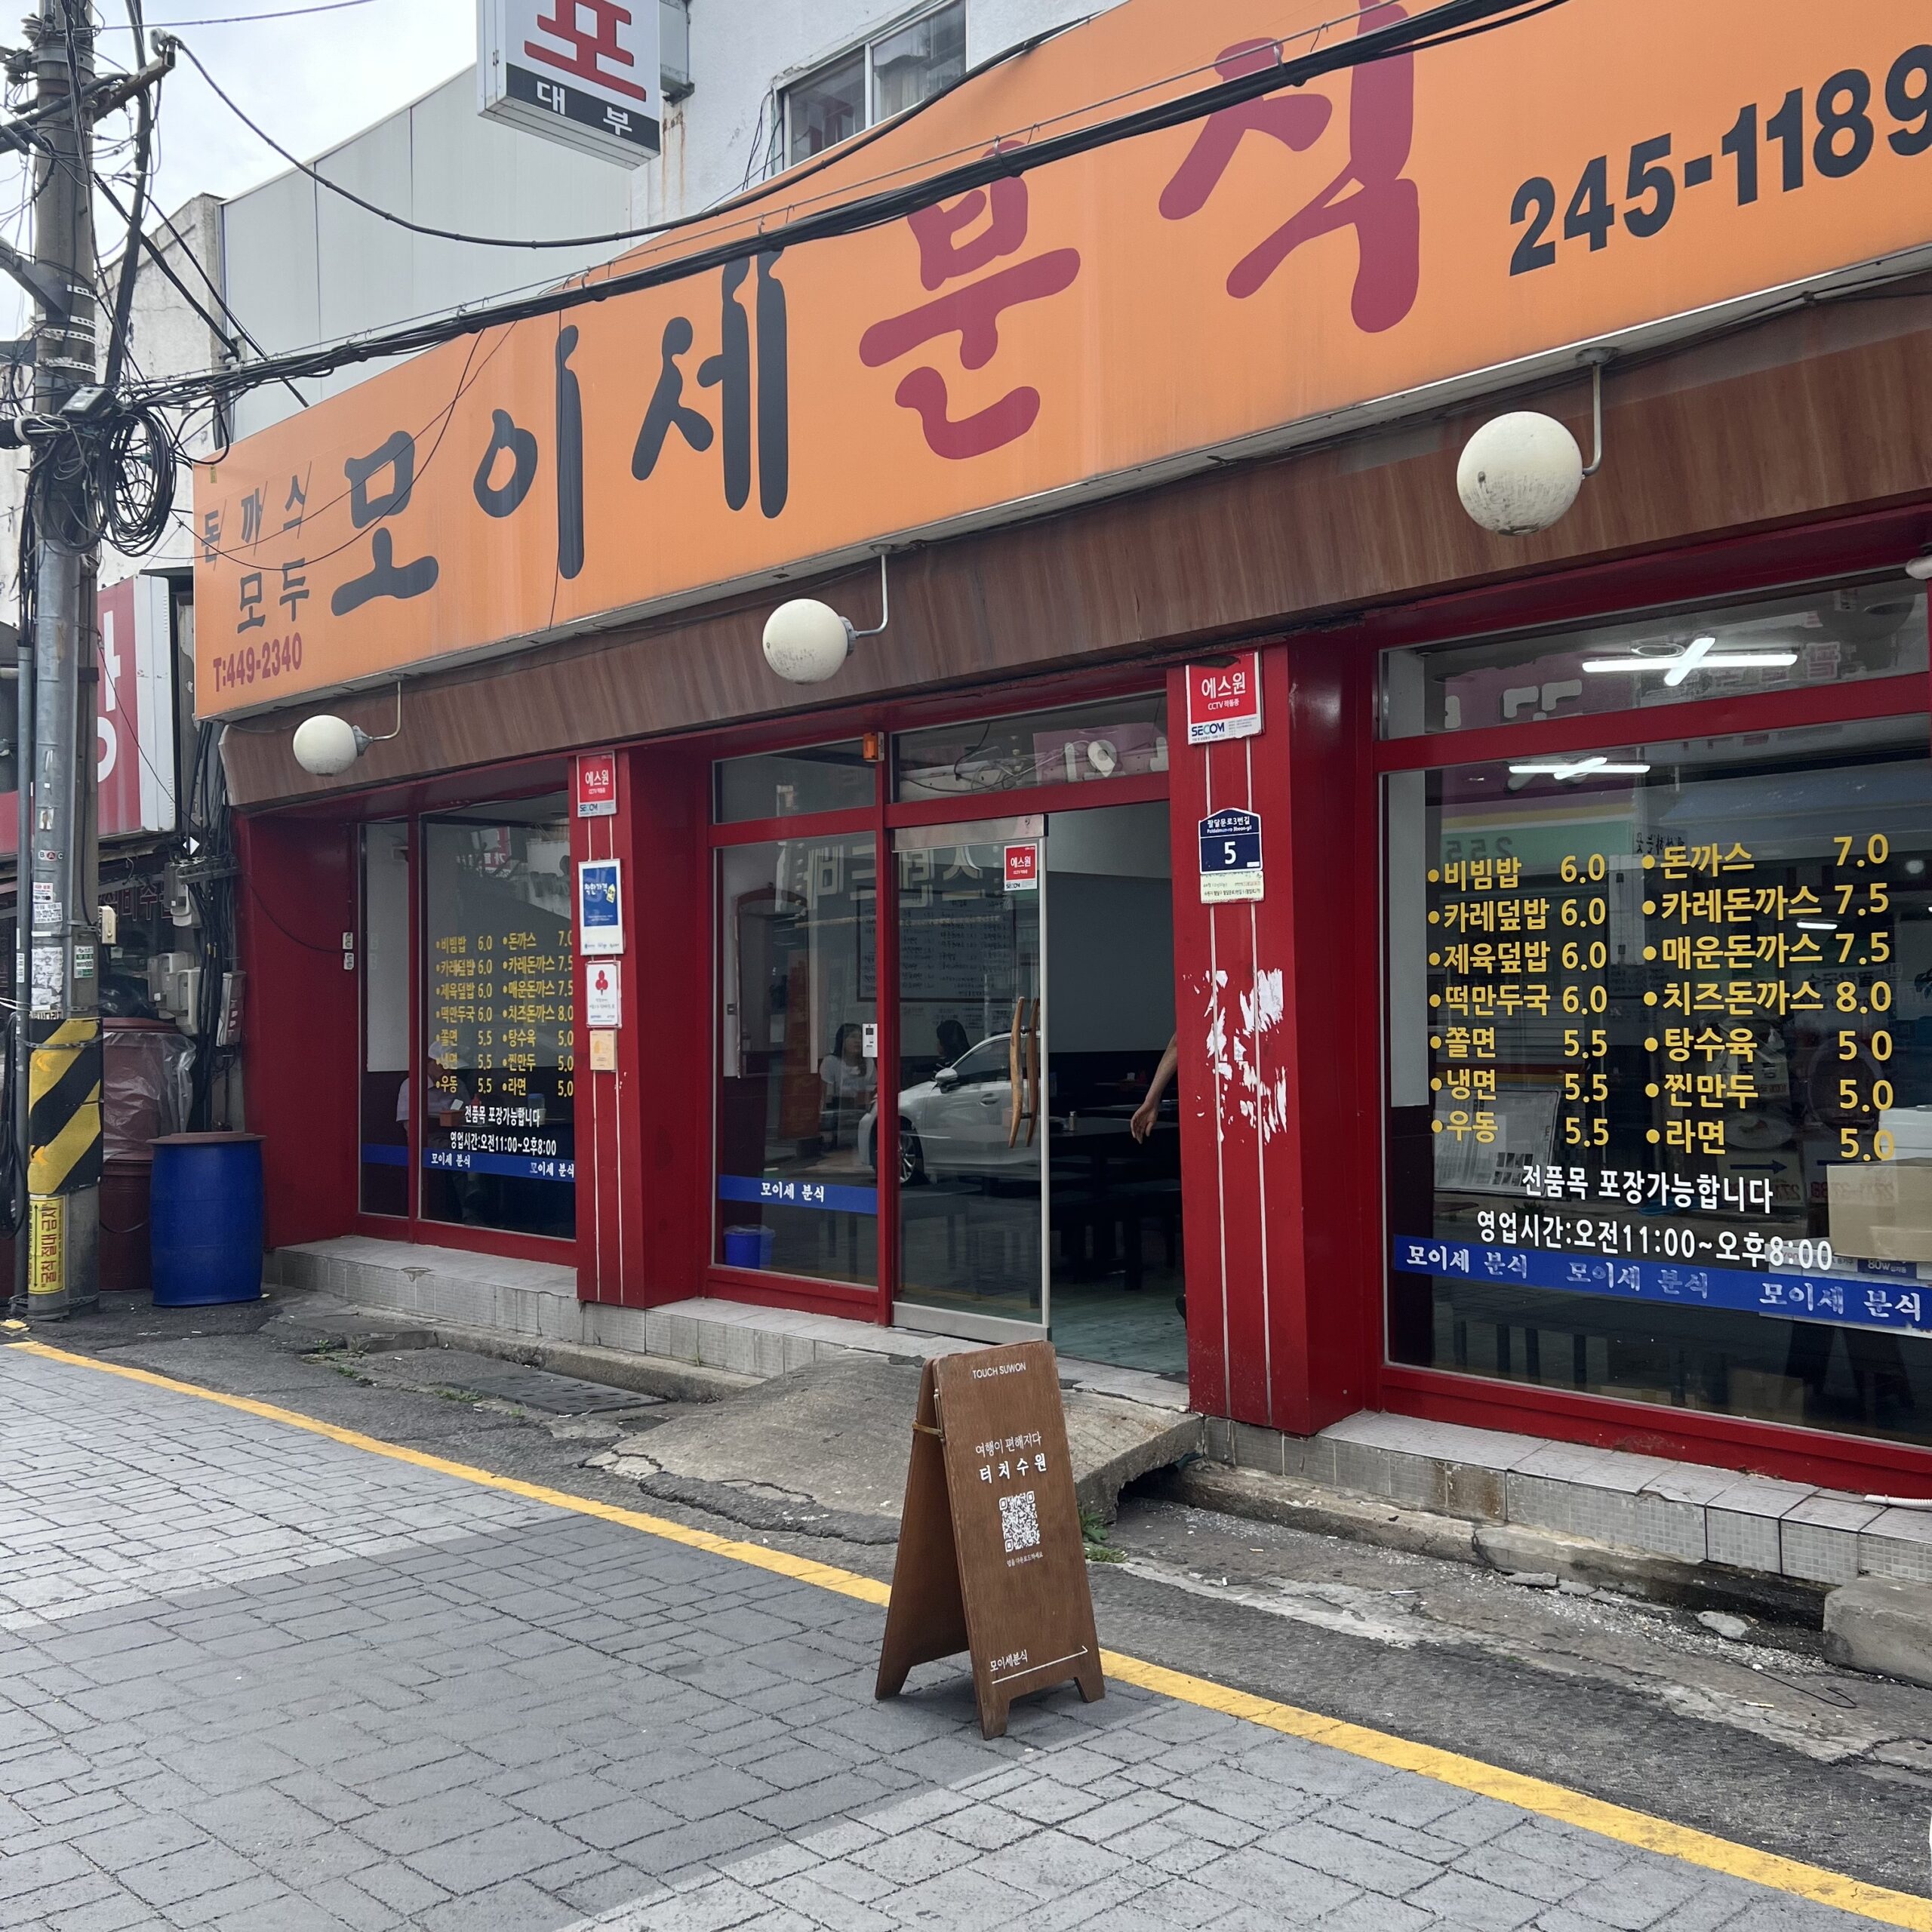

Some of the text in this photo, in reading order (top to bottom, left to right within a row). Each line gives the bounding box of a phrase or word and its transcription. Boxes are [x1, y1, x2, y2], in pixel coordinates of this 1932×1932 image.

[1509, 43, 1932, 277] 245-1189
[331, 0, 1421, 617] 모이세 분식
[237, 557, 310, 635] 모두
[212, 632, 303, 693] T:449-2340
[1201, 672, 1247, 700] 에스원
[1208, 701, 1223, 711] CCTV
[1191, 721, 1225, 737] SECOM
[584, 769, 609, 786] 에스원
[1010, 855, 1032, 868] 에스원
[1224, 841, 1237, 865] 5
[1660, 842, 1755, 879] 돈까스
[1834, 833, 1889, 867] 7.0
[1444, 853, 1605, 891] 비빔밥 6.0
[1444, 897, 1606, 933] 카레덮밥 6.0
[1661, 882, 1890, 924] 카레돈까스 7.5
[478, 935, 493, 951] 6.0
[509, 931, 537, 950] 돈까스
[1662, 932, 1890, 970] 매운돈까스 7.5
[478, 959, 493, 975] 6.0
[508, 955, 574, 974] 카레돈까스 7.5
[1444, 940, 1607, 975] 제육덮밥 6.0
[478, 983, 493, 998] 6.0
[508, 980, 574, 998] 매운돈까스 7.5
[1445, 984, 1607, 1017] 떡만두국 6.0
[1663, 980, 1892, 1016] 치즈돈까스 8.0
[478, 1006, 493, 1023] 6.0
[508, 1004, 574, 1023] 치즈돈까스 8.0
[478, 1030, 493, 1046] 5.5
[508, 1029, 574, 1048] 탕수육 5.0
[1445, 1026, 1608, 1059] 쫄면 5.5
[1664, 1027, 1758, 1063] 탕수육
[478, 1054, 493, 1070] 5.5
[508, 1054, 574, 1072] 찐만두 5.0
[441, 1075, 493, 1094] 우동 5.5
[508, 1077, 574, 1097] 라면 5.0
[1447, 1068, 1609, 1103] 냉면 5.5
[1663, 1073, 1758, 1109] 찐만두
[1839, 1078, 1894, 1112] 5.0
[465, 1105, 540, 1128] 전품목 포장가능합니다
[1446, 1110, 1610, 1148] 우동 5.5
[1666, 1118, 1895, 1162] 라면 5.0
[431, 1152, 471, 1168] 모이세 분식
[529, 1161, 574, 1179] 모이세 분식
[760, 1181, 825, 1203] 모이세 분식
[1521, 1164, 1589, 1201] 전품목
[1598, 1170, 1774, 1214] 포장가능합니다
[1406, 1245, 1527, 1279] 모이세 분식
[1566, 1262, 1709, 1299] 모이세 분식
[1759, 1282, 1921, 1322] 모이세 분식
[972, 1361, 1026, 1380] TOUCH SUWON
[975, 1431, 1041, 1458] 여행이 편해지다
[989, 1649, 1028, 1672] 모이세분식
